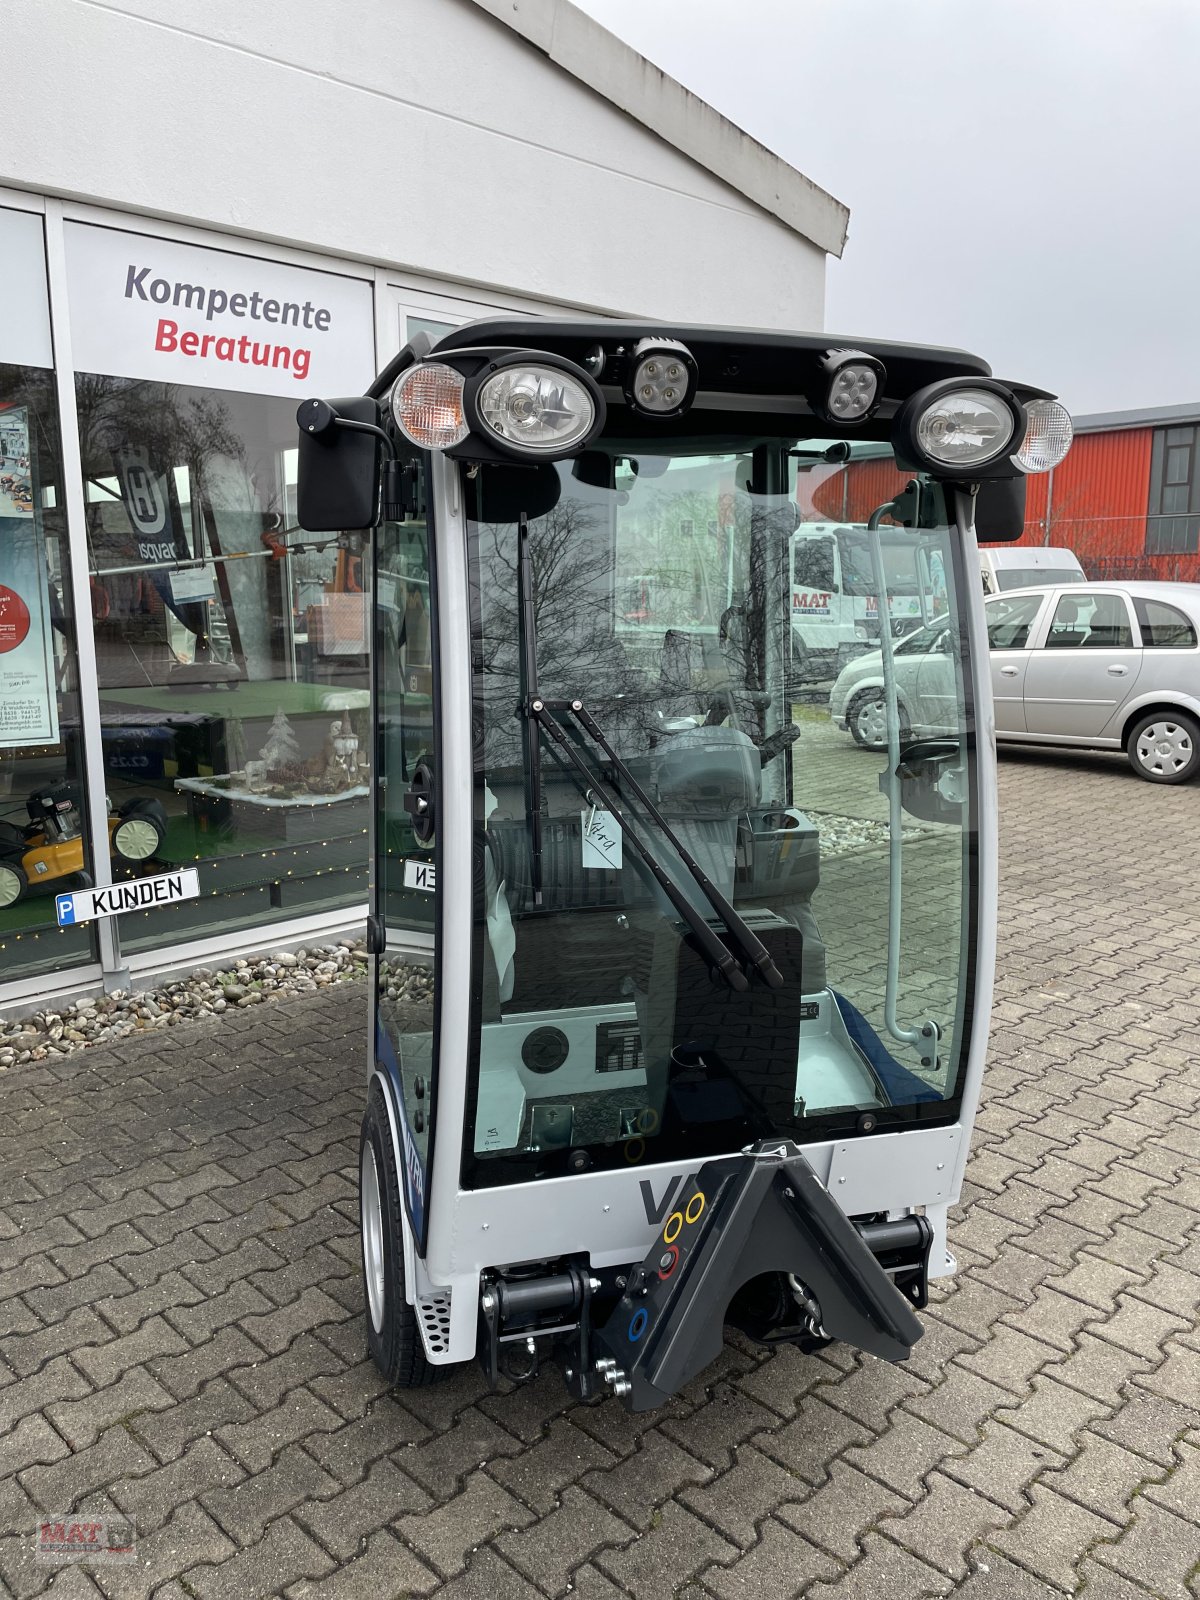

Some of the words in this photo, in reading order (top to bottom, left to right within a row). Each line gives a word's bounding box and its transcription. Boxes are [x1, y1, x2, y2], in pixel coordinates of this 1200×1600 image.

[124, 264, 331, 331] Kompetente
[154, 319, 311, 380] Beratung
[793, 593, 832, 608] MAT
[60, 900, 73, 920] P
[92, 876, 183, 915] KUNDEN
